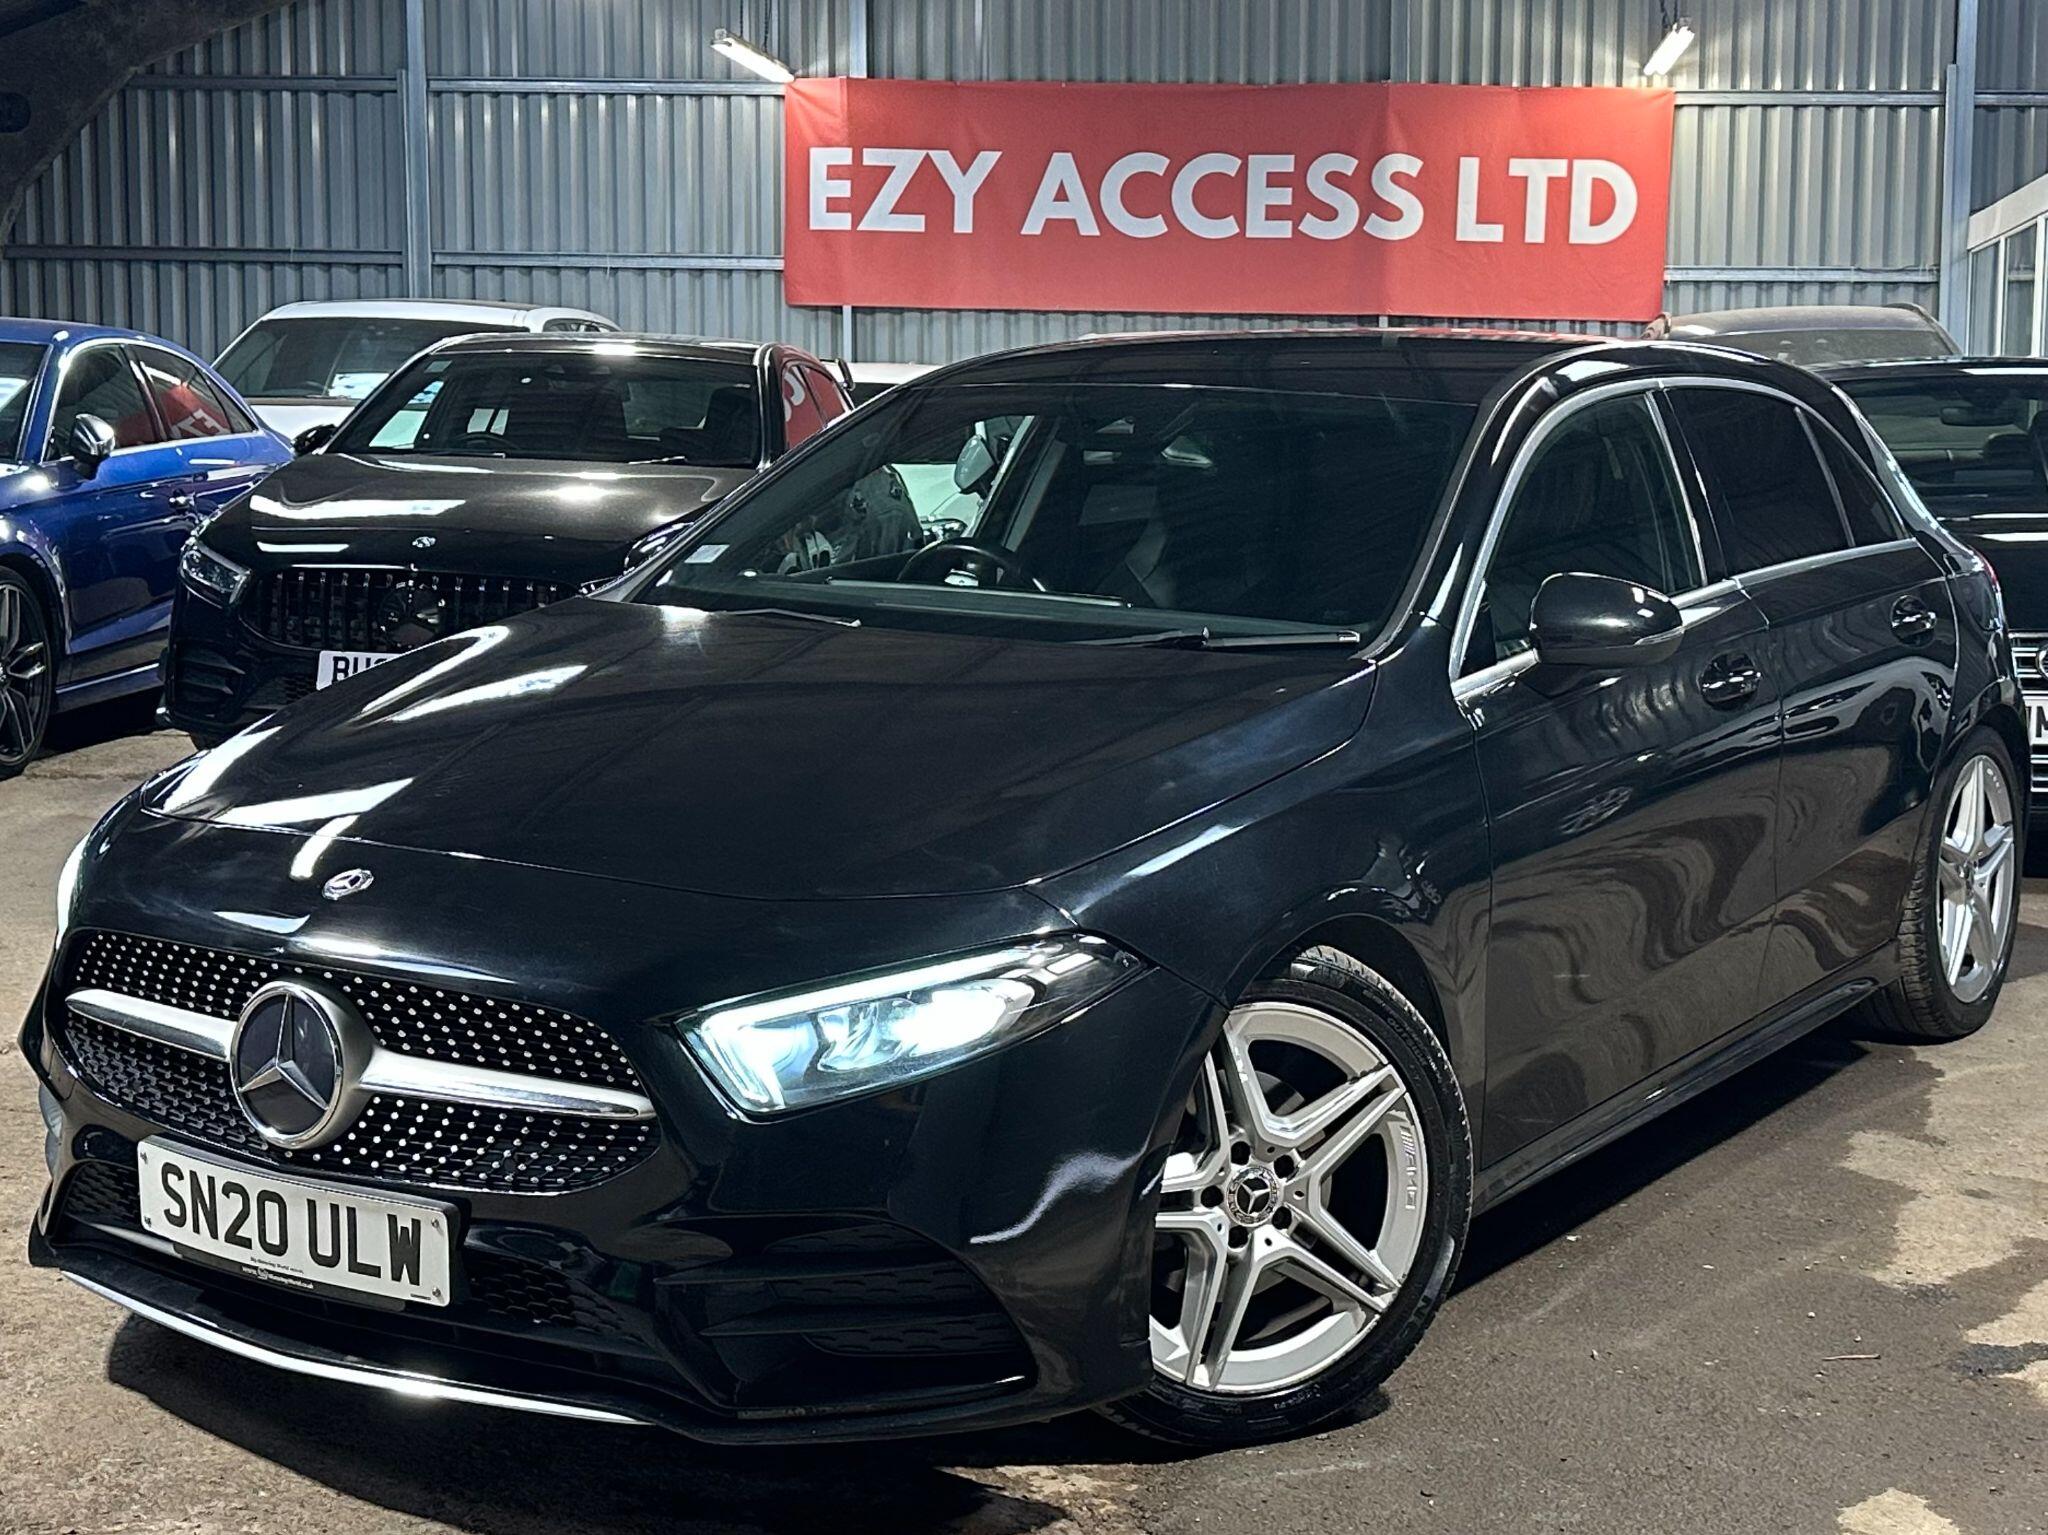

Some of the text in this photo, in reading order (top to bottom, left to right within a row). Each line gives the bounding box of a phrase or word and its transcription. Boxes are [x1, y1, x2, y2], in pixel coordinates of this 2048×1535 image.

[808, 146, 1638, 245] EZY ACCESS LTD
[331, 655, 388, 684] BU
[161, 1161, 422, 1287] SN20 ULW
